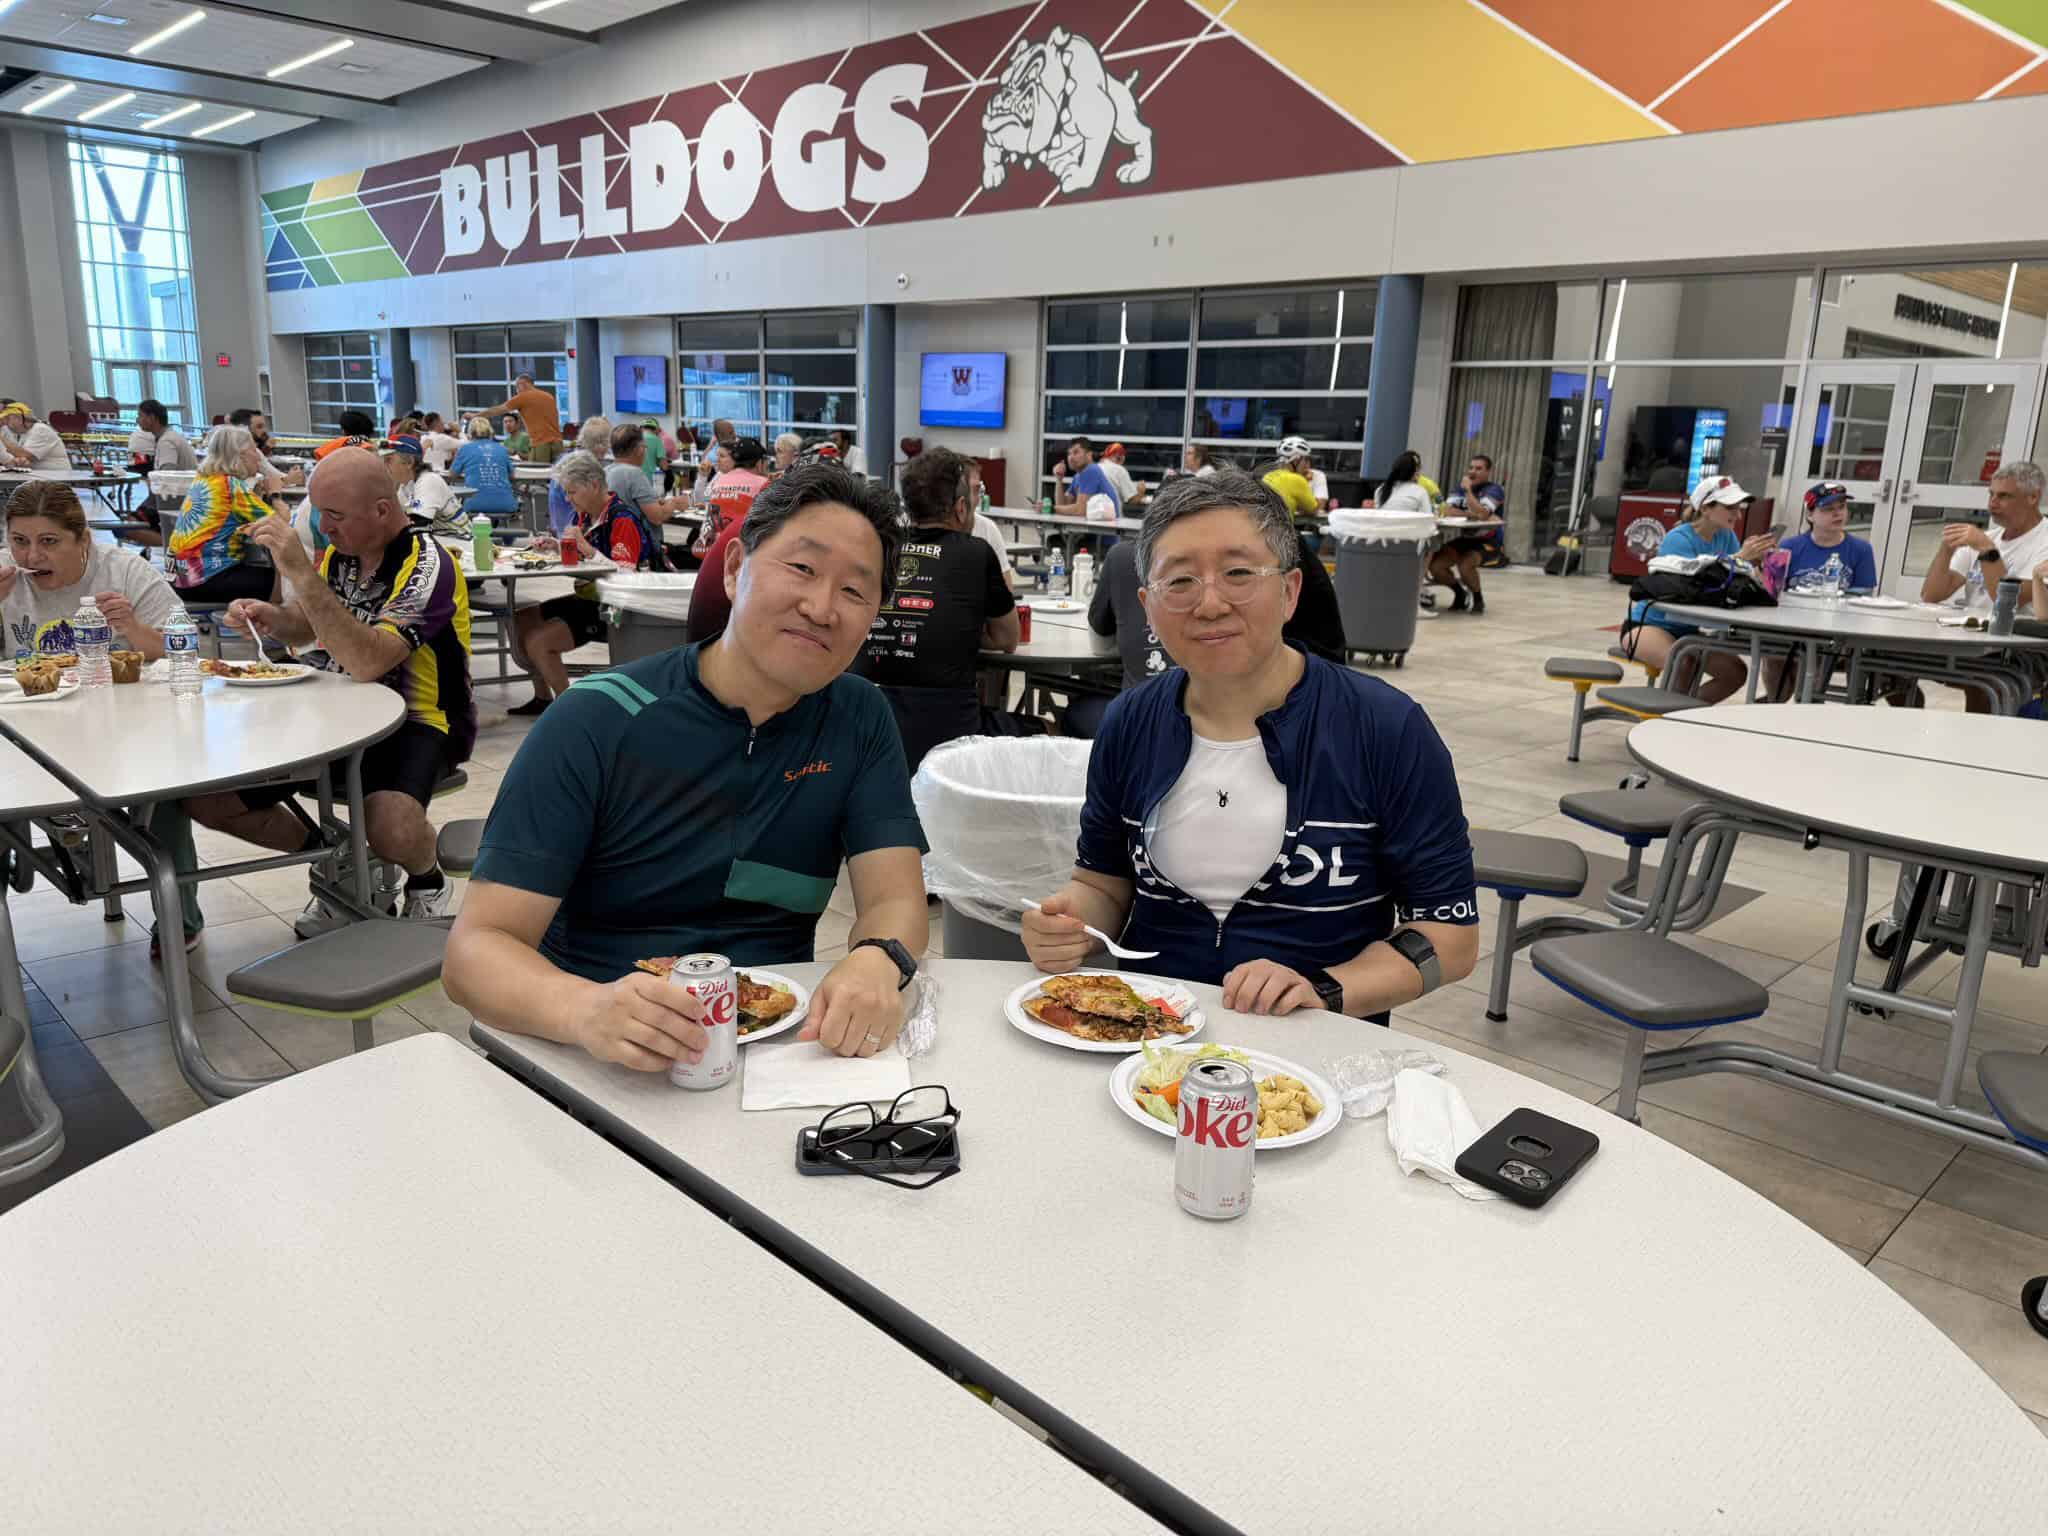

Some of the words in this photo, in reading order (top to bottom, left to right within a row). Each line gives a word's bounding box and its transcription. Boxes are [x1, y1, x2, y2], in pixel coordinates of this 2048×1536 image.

[440, 63, 930, 257] BULLDOGS
[951, 366, 973, 386] W
[1433, 900, 1476, 921] COL
[699, 977, 729, 995] Diet
[1212, 1095, 1248, 1112] Diet
